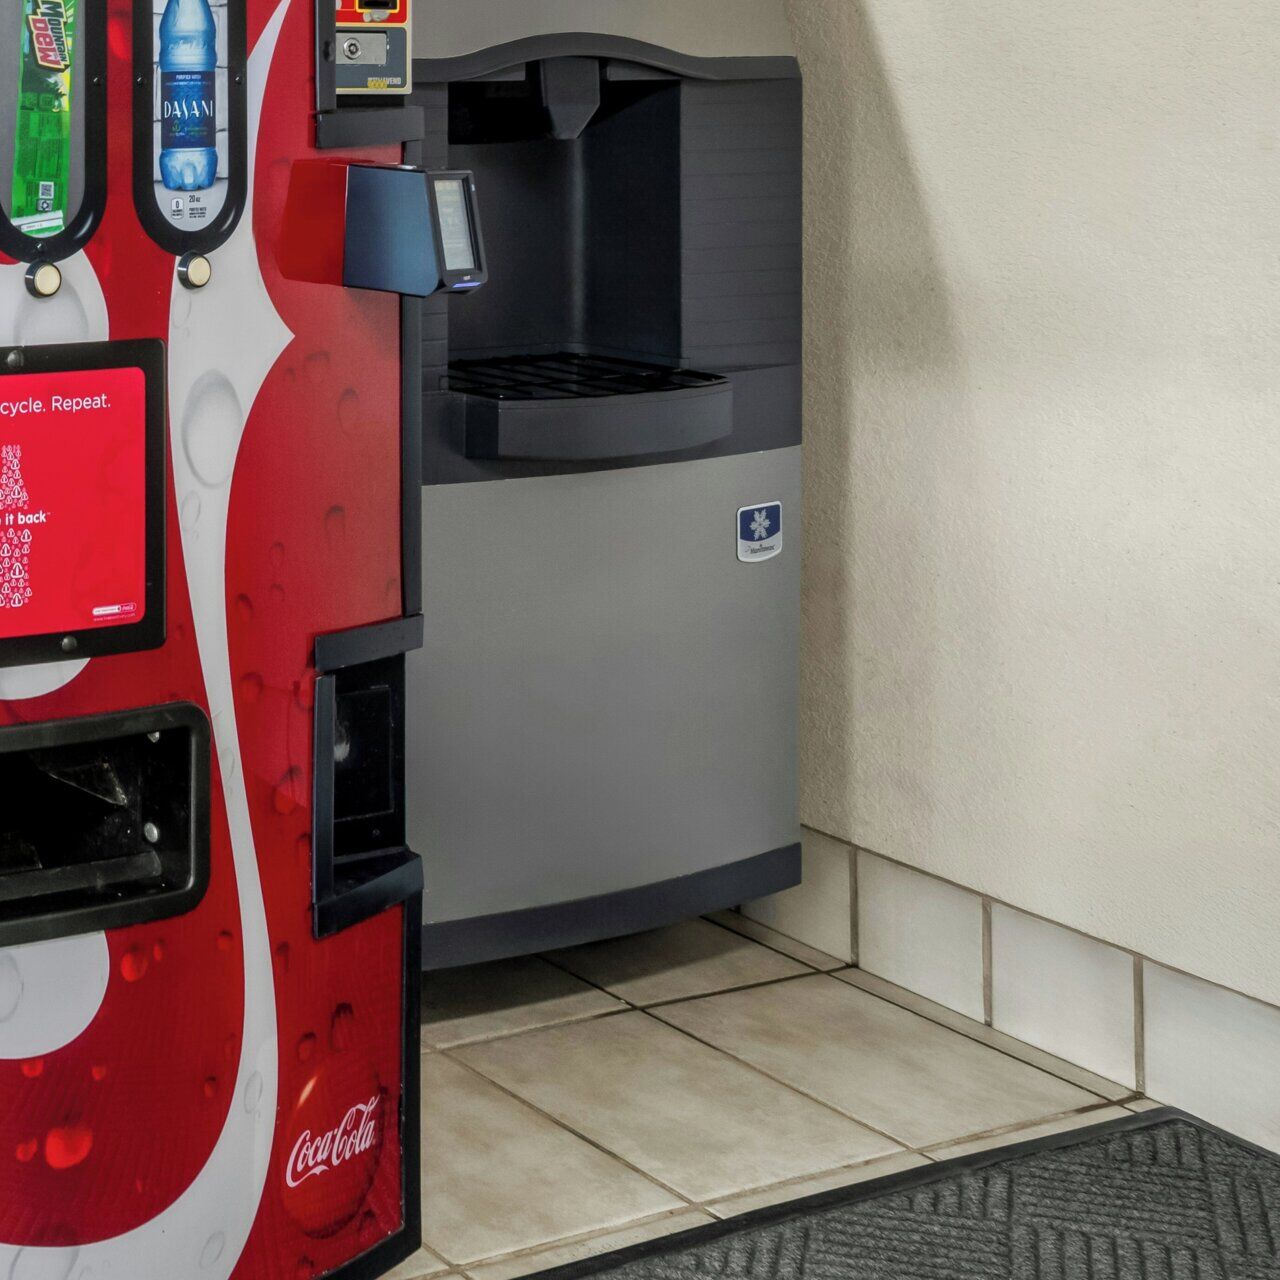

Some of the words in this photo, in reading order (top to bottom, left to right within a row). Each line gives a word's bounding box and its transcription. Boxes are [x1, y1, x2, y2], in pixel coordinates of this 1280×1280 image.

[164, 99, 213, 120] DASANI
[51, 393, 111, 412] Repeat.
[5, 513, 15, 526] it
[17, 510, 47, 526] back
[285, 1092, 382, 1189] Coca-Cola
